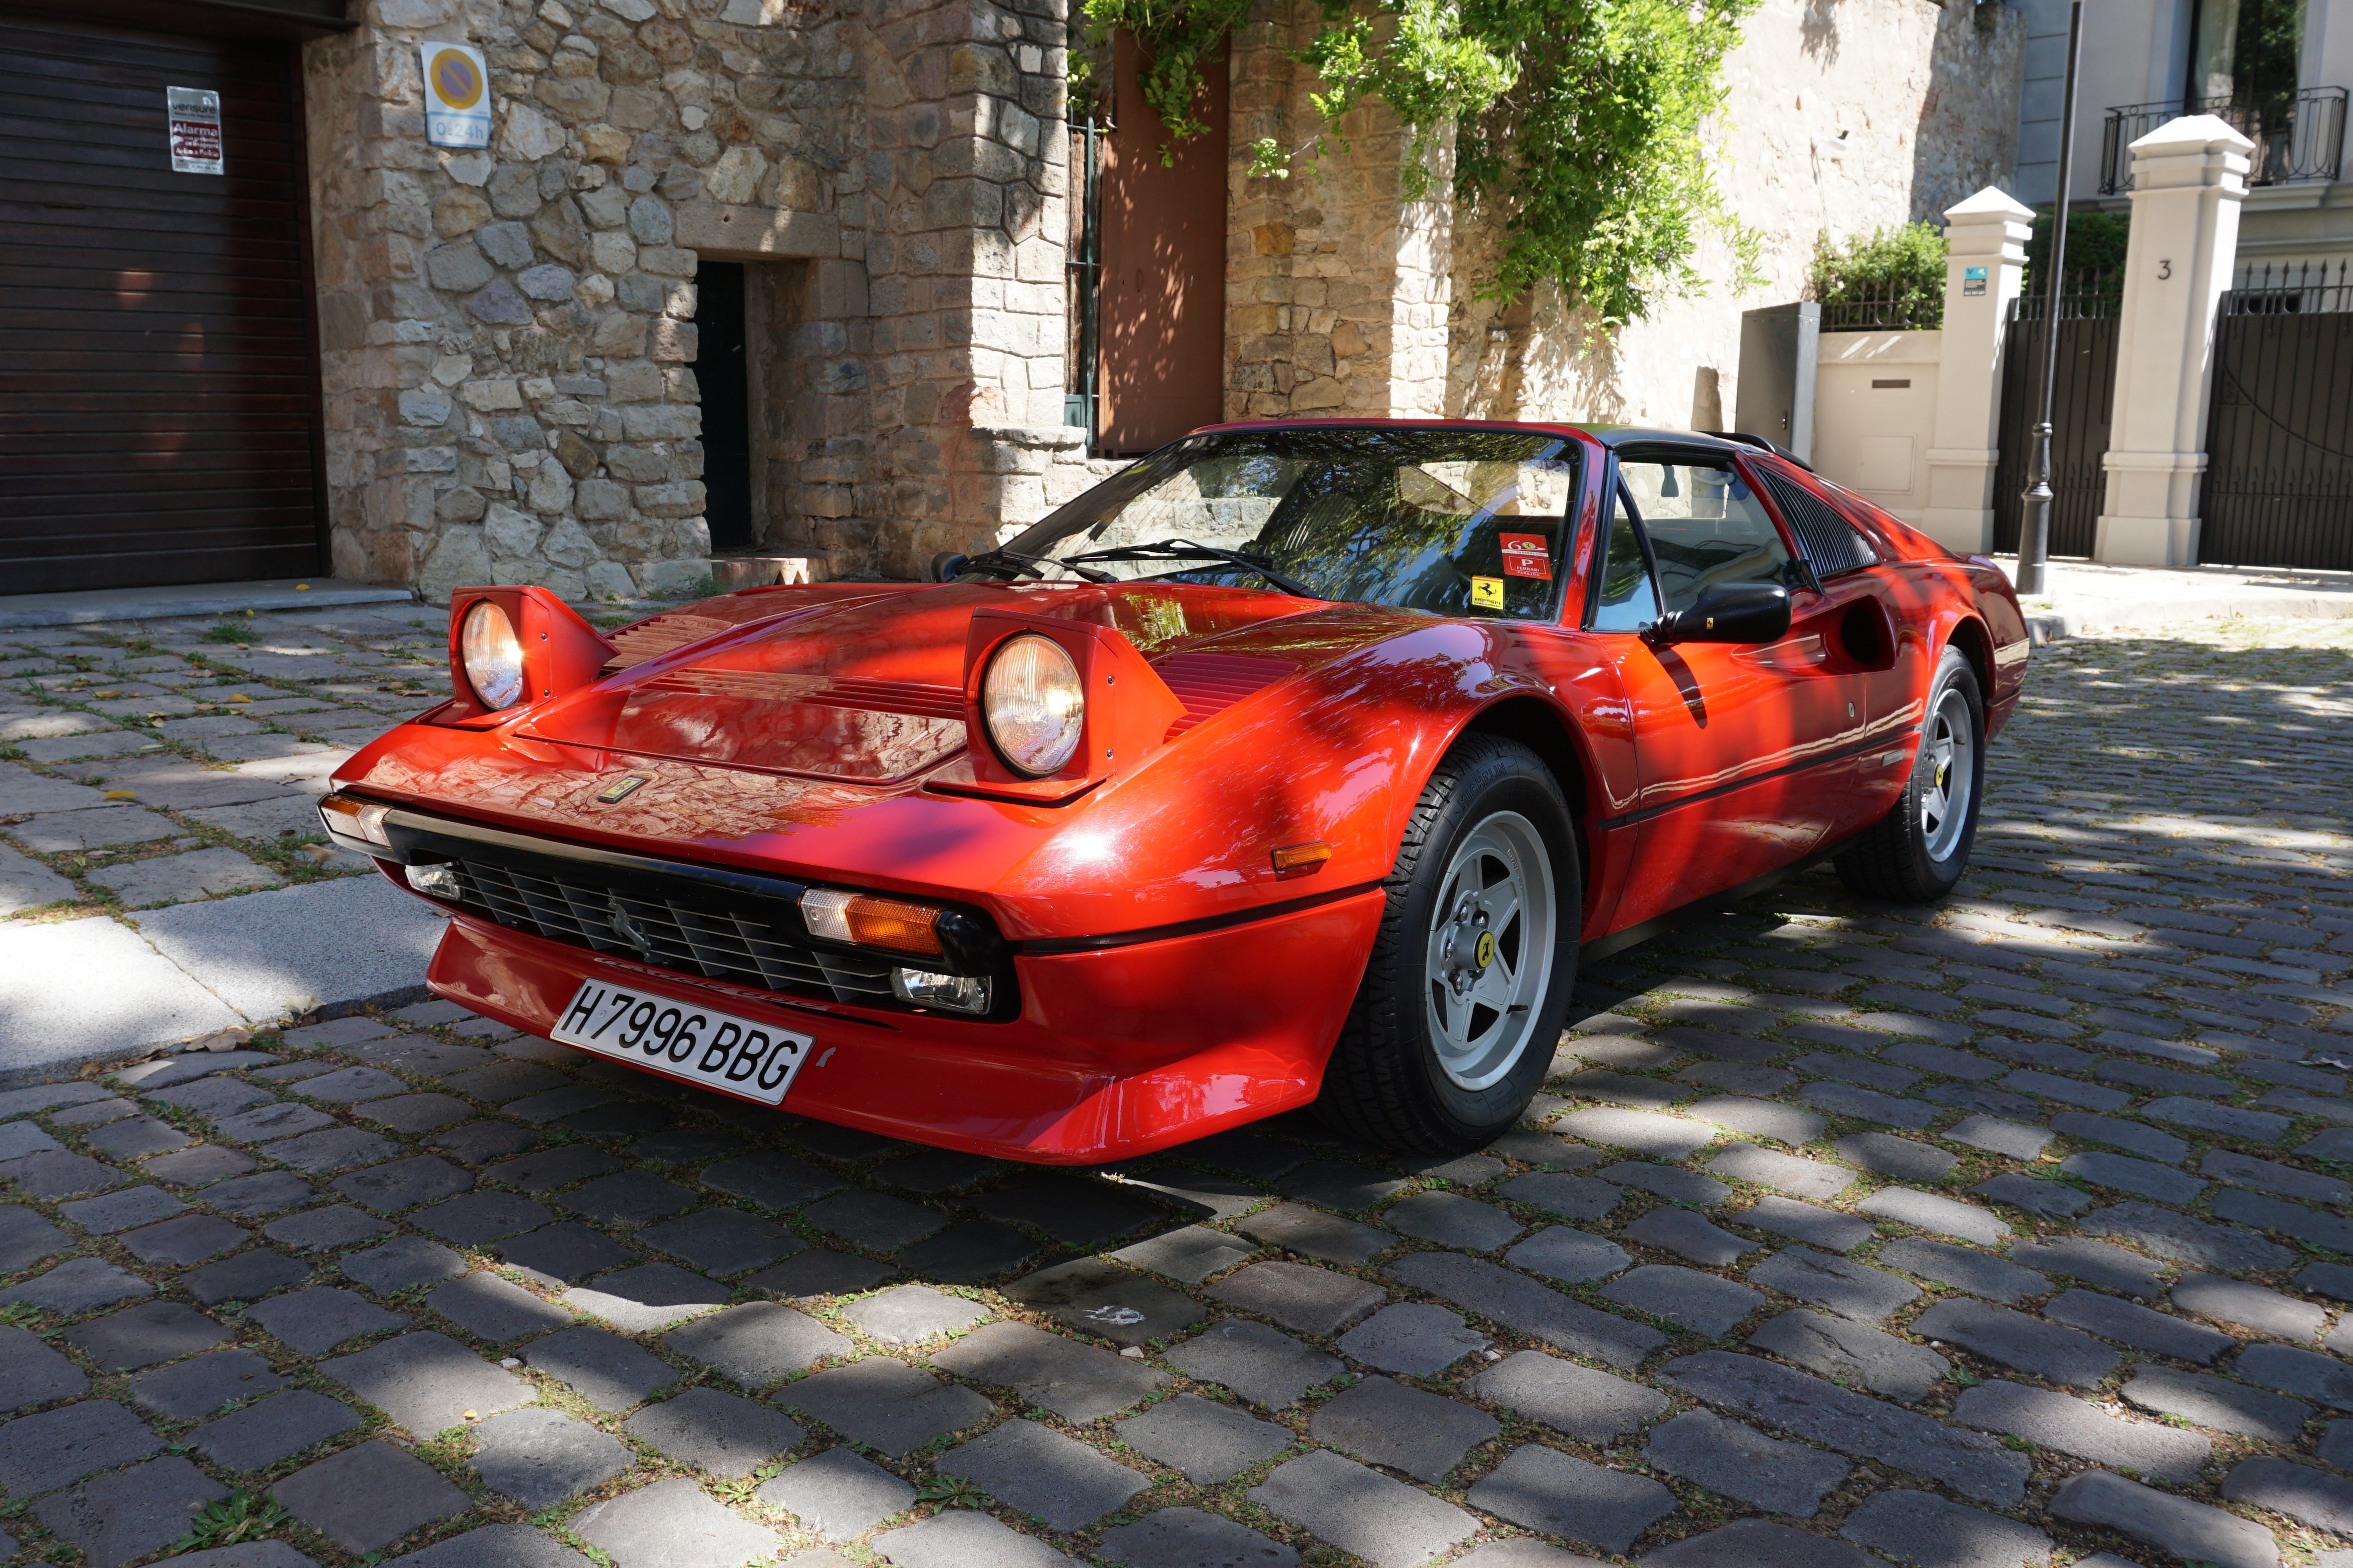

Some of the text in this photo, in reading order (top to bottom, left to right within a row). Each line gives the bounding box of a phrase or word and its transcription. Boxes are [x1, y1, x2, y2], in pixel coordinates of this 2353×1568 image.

[172, 103, 216, 114] verisure
[173, 123, 218, 136] Alarma
[2157, 260, 2171, 280] 3
[1457, 762, 1506, 811] MICHELIN
[561, 985, 798, 1090] H 7996 BBG
